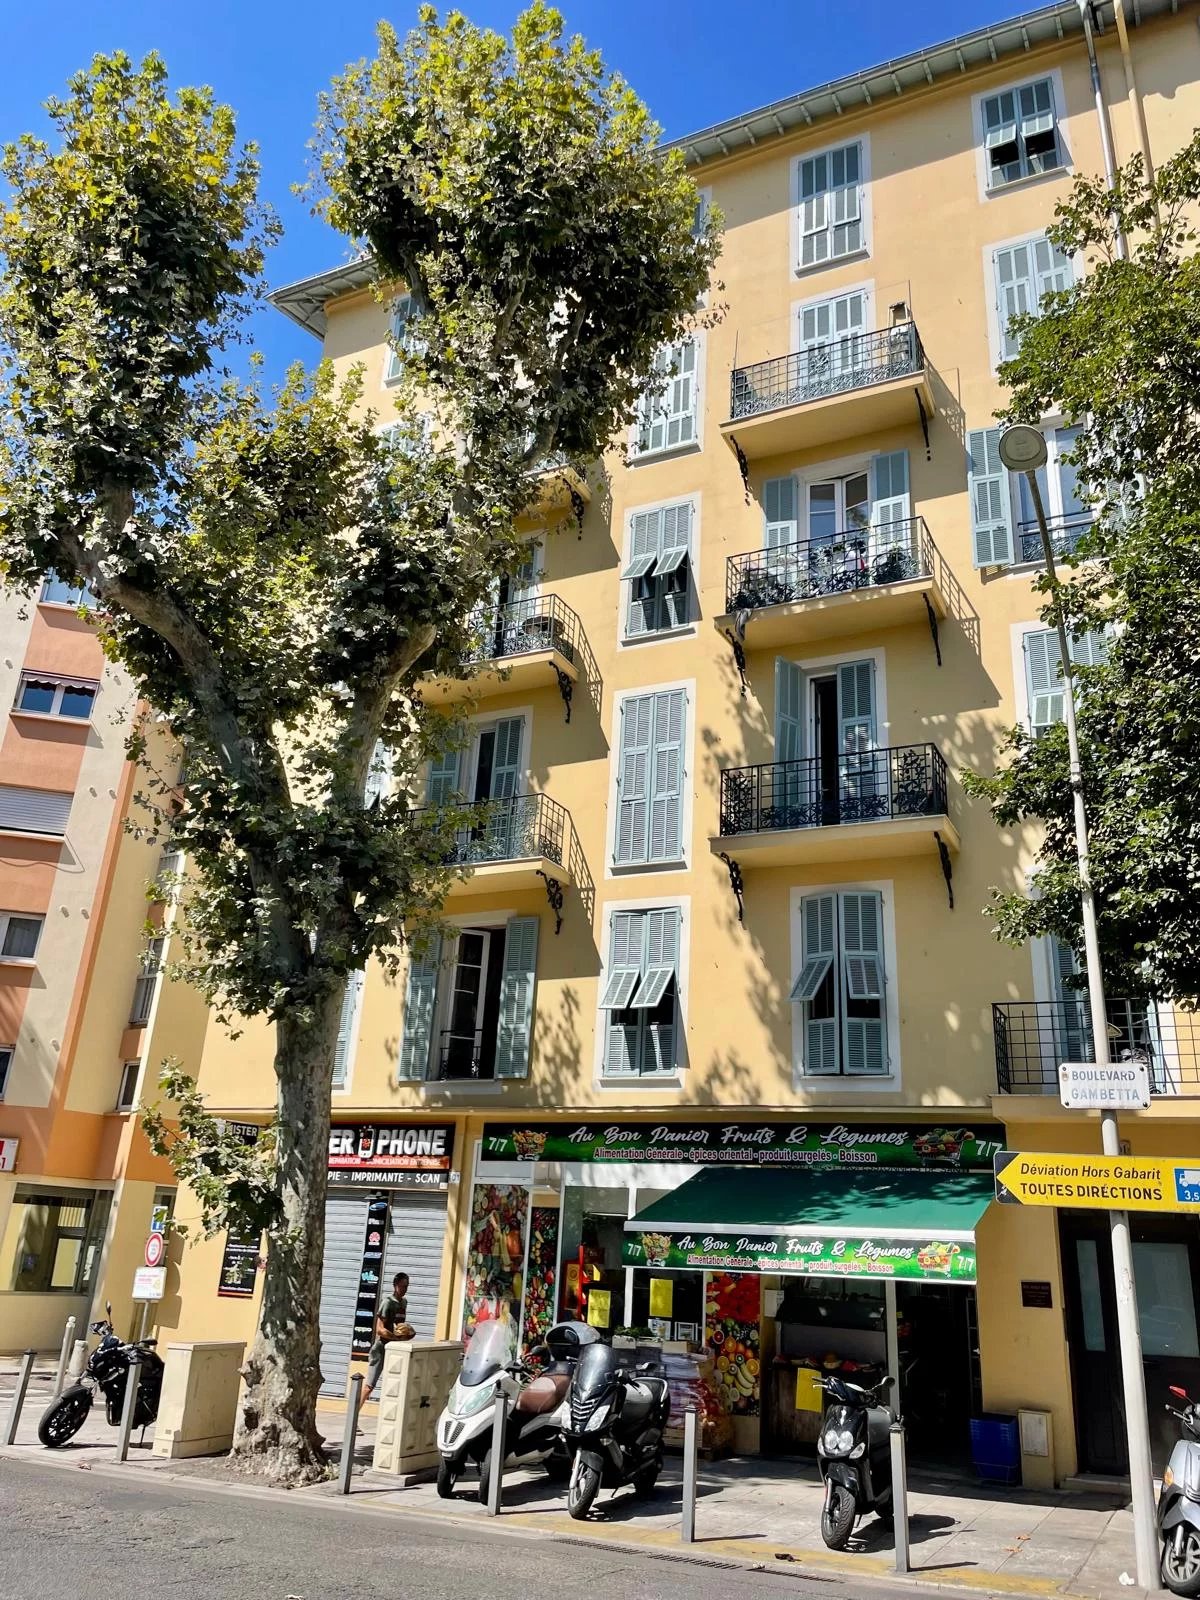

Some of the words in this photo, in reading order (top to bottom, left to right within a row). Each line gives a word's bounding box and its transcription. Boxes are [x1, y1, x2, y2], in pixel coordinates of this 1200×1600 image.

[1071, 1070, 1136, 1081] BOULEVARD
[1071, 1088, 1140, 1101] GAMBETTA
[232, 1124, 257, 1137] ISTER
[568, 1126, 595, 1143] Au
[603, 1127, 641, 1144] Bon
[649, 1126, 710, 1144] Panier
[720, 1126, 776, 1145] Fruits
[785, 1126, 808, 1145] &
[819, 1125, 909, 1147] Légumes
[328, 1129, 356, 1155] ER
[376, 1129, 447, 1155] PHONE
[488, 1136, 508, 1153] 7/7
[974, 1139, 1003, 1157] 7/7
[594, 1146, 644, 1159] Alimentation
[645, 1147, 683, 1160] Générale
[688, 1148, 717, 1162] épices
[718, 1148, 752, 1161] oriental
[758, 1148, 791, 1163] produit
[838, 1149, 877, 1162] Boisson
[327, 1171, 340, 1181] PIE
[351, 1172, 404, 1182] IMPRIMANTE
[414, 1174, 441, 1183] SCAN
[1020, 1163, 1079, 1177] Déviation
[1082, 1165, 1110, 1178] Hors
[1113, 1166, 1161, 1180] Gabarit
[1020, 1182, 1074, 1197] TOUTES
[627, 1243, 642, 1257] 7/7
[676, 1235, 697, 1250] Au
[701, 1236, 730, 1252] Bon
[736, 1237, 779, 1254] Panier
[785, 1238, 824, 1256] Fruits
[830, 1240, 846, 1256] &
[854, 1240, 915, 1260] Légumes
[686, 1254, 725, 1266] Alimentation
[808, 1258, 832, 1272] produit
[866, 1262, 894, 1273] Boisson
[956, 1255, 975, 1272] 7/7
